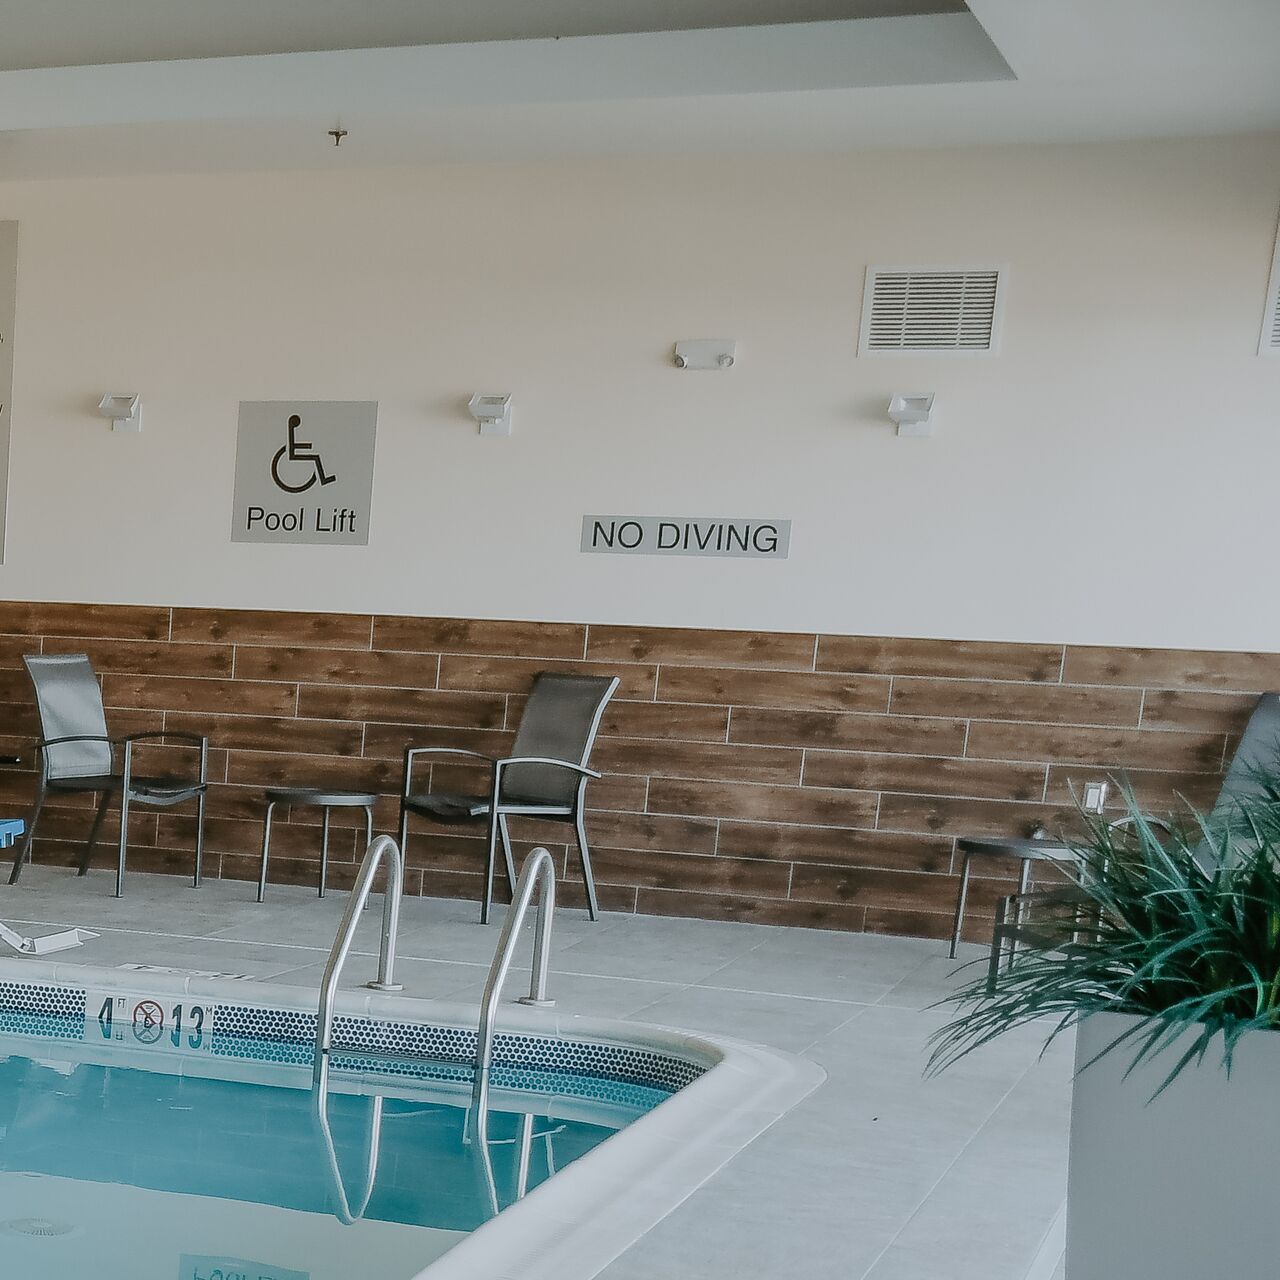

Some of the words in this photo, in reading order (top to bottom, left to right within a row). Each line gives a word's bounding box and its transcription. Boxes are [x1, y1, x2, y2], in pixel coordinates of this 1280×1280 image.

[246, 506, 304, 531] Pool
[315, 508, 356, 532] Lift
[592, 521, 643, 548] NO
[657, 523, 778, 552] DIVING
